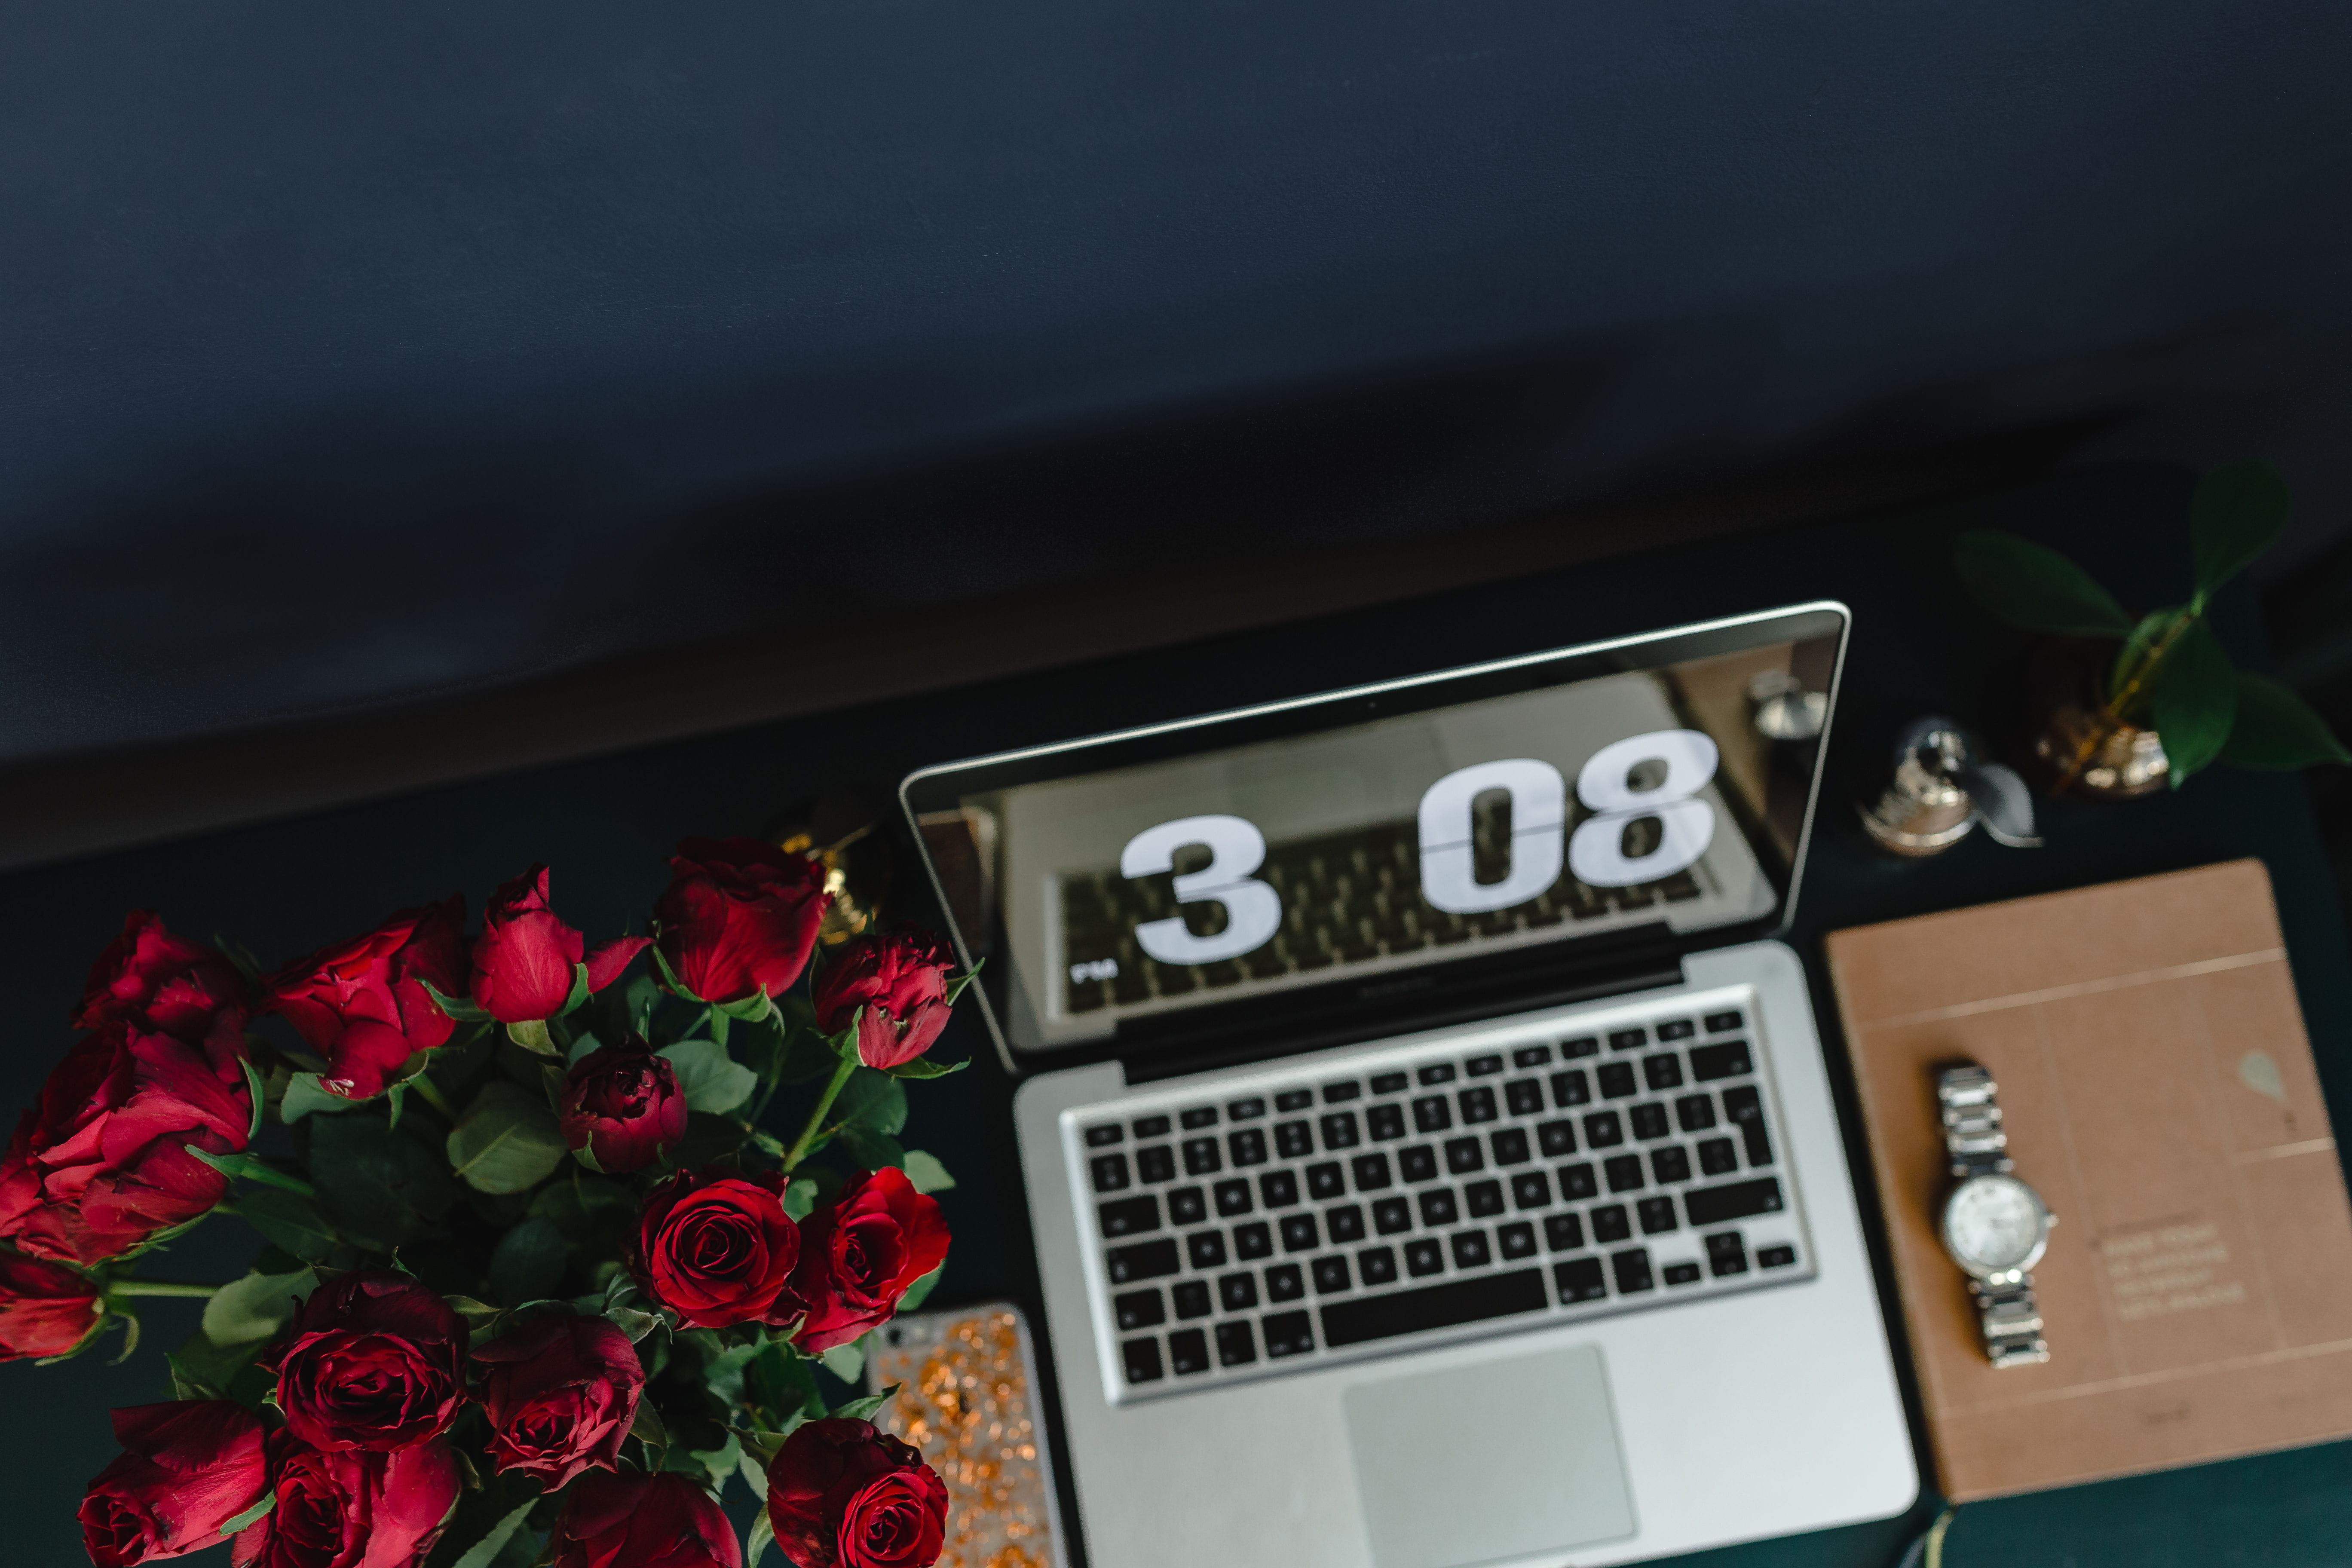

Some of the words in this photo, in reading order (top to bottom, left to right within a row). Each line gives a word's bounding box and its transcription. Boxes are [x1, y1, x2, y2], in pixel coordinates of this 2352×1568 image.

[1119, 814, 1281, 965] 3
[1417, 728, 1719, 914] 08
[1070, 958, 1118, 984] PM
